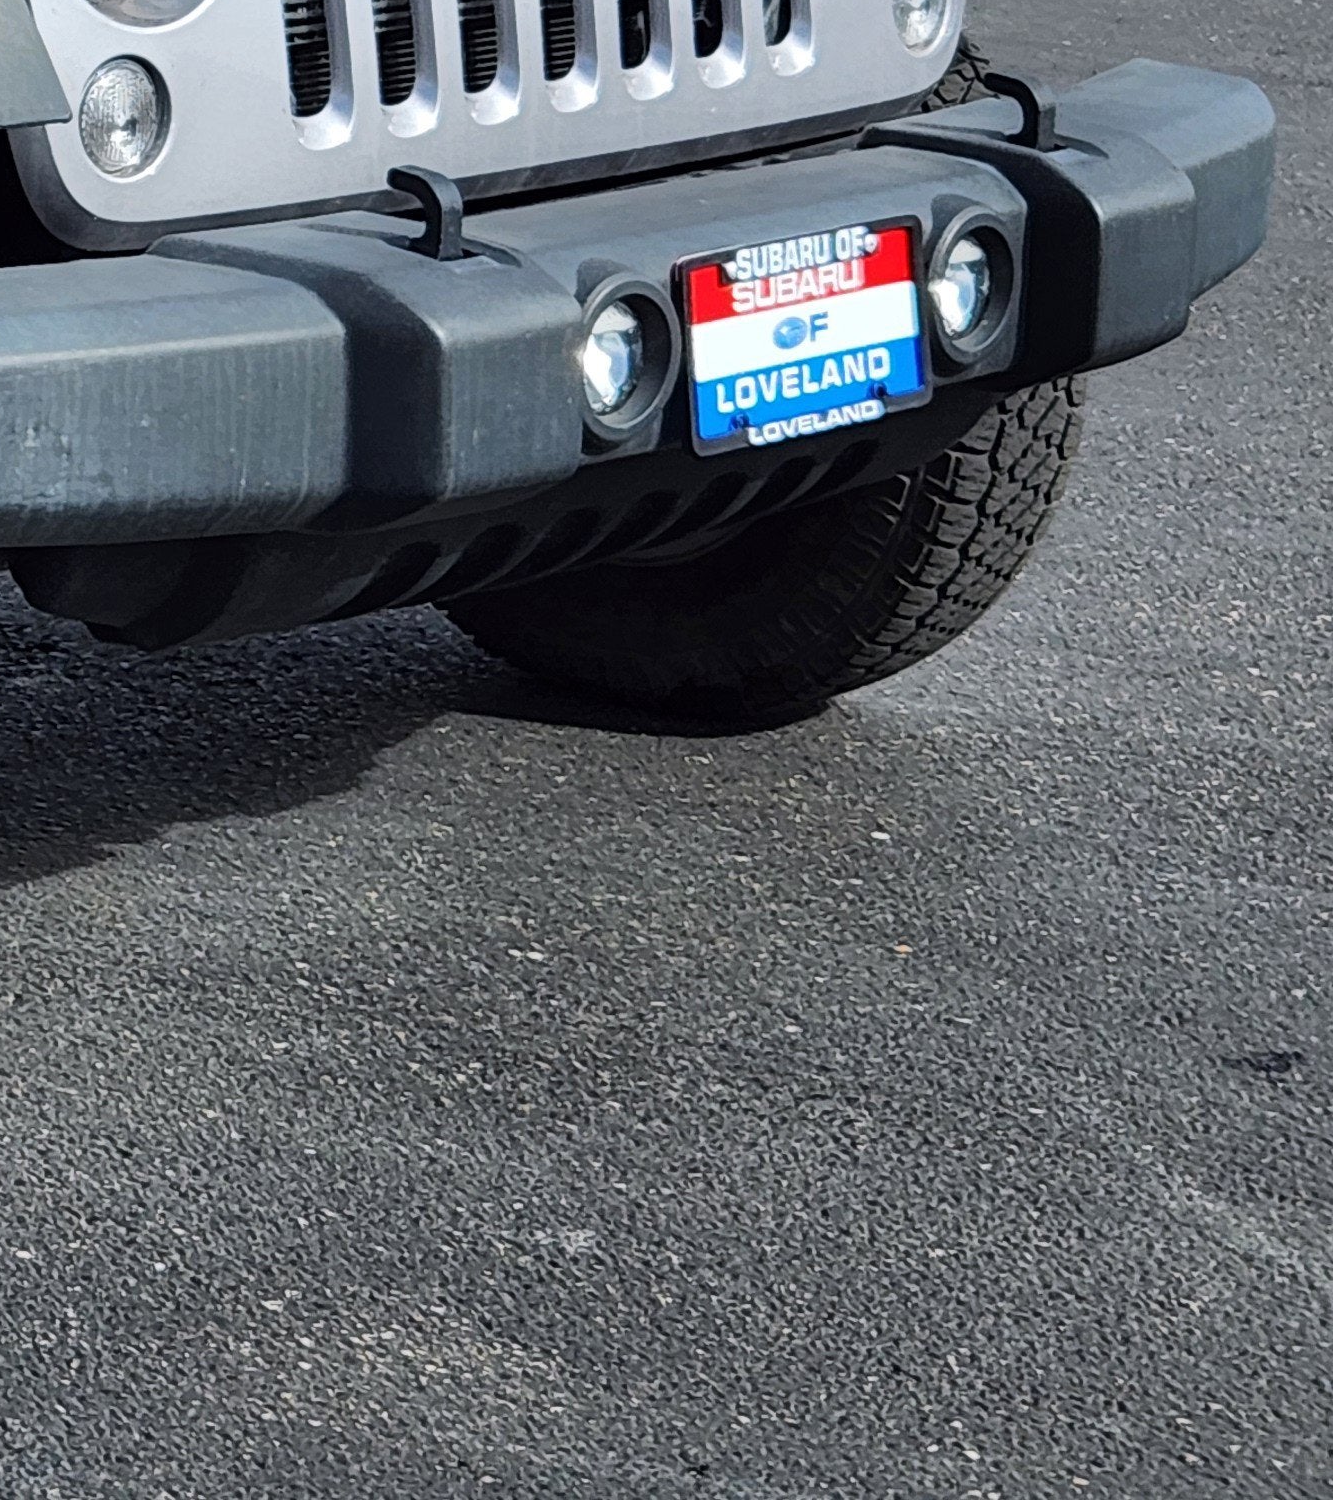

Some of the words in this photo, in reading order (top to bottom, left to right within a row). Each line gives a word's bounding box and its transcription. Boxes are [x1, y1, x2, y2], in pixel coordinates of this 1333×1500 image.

[736, 234, 831, 280] SUBARU
[835, 226, 868, 262] OF
[732, 260, 865, 313] SUBARU
[716, 347, 890, 414] LOVELAND
[748, 400, 884, 446] LOVELAND
